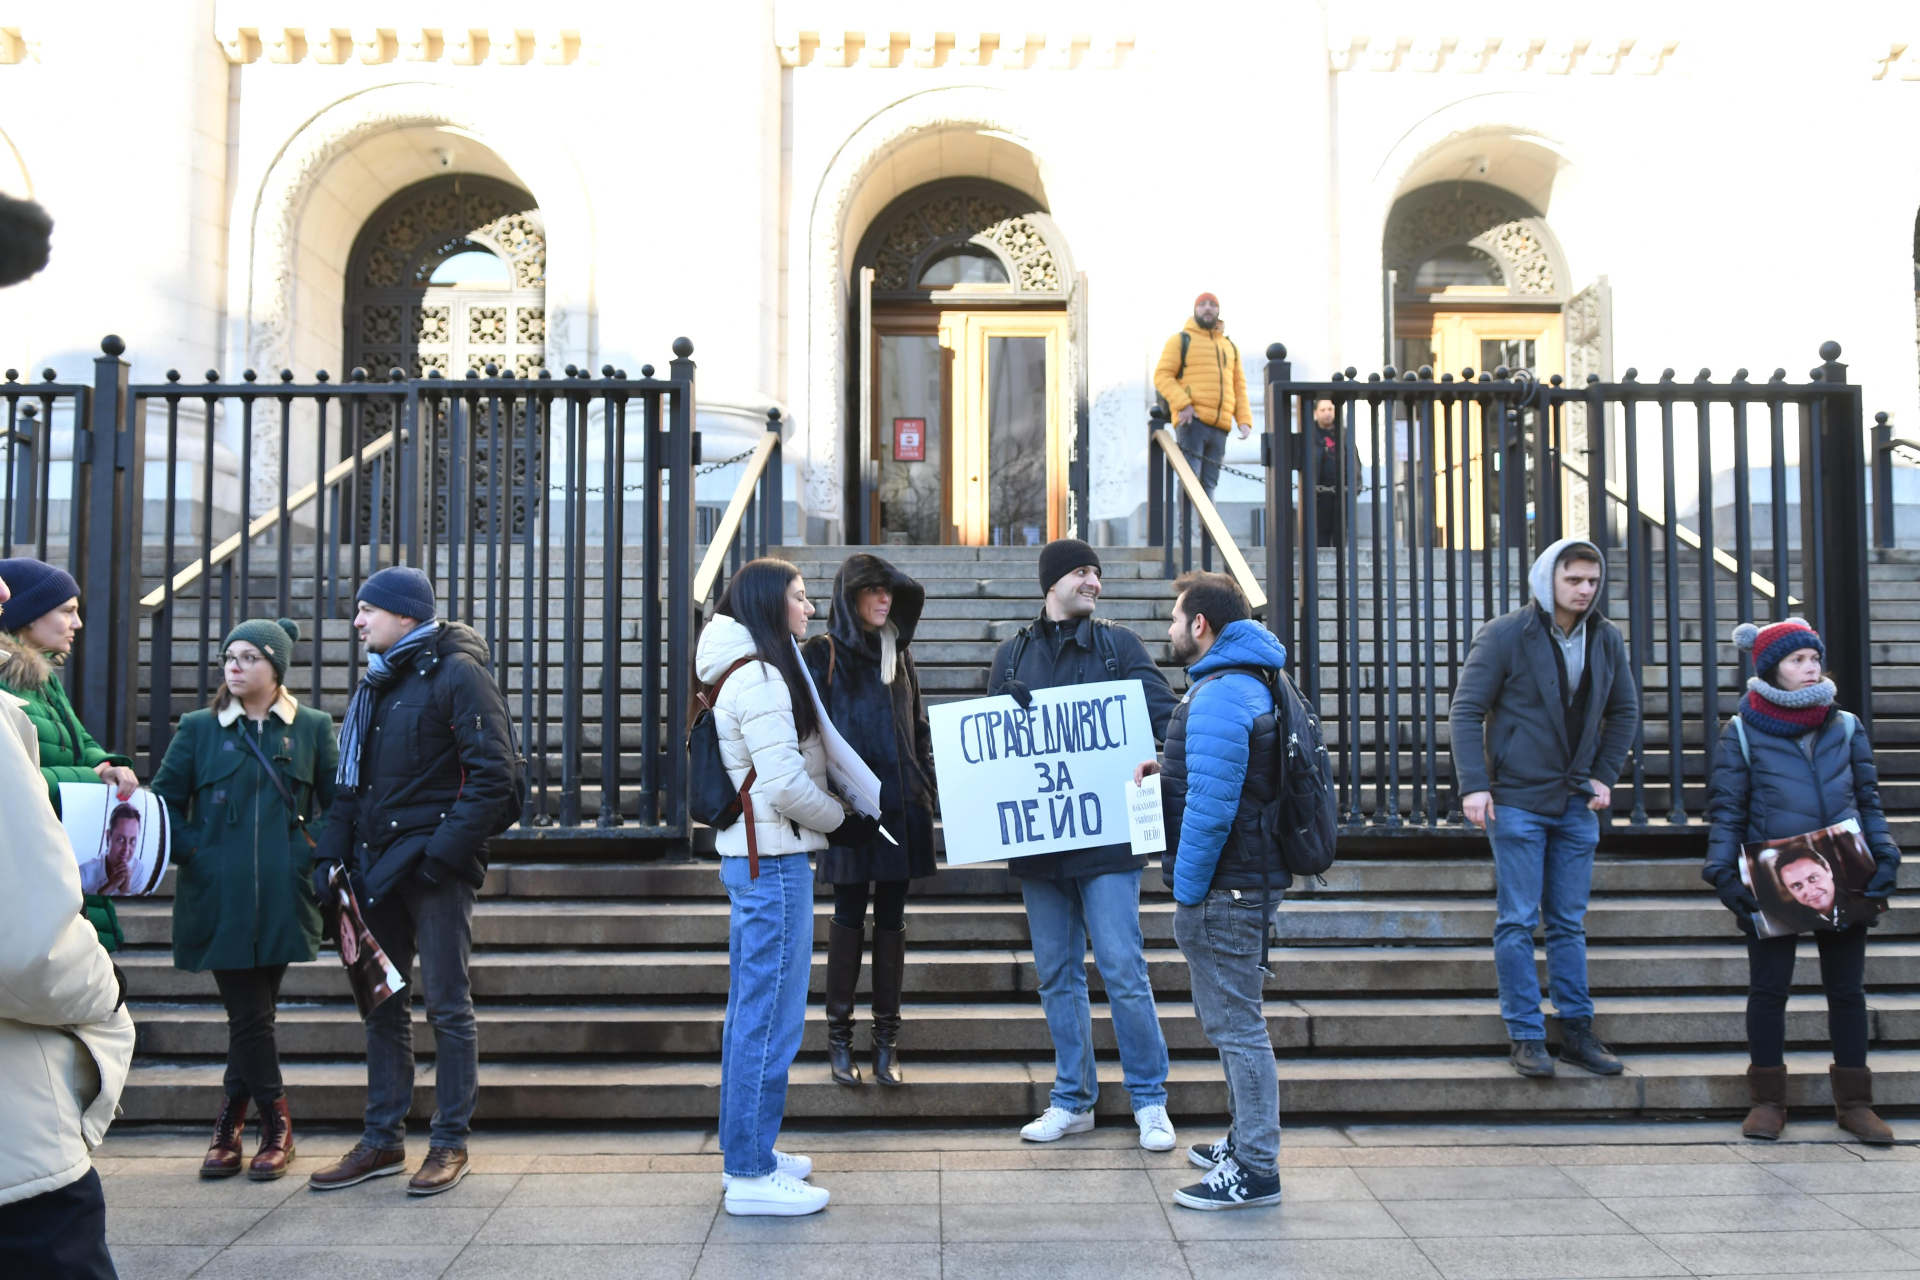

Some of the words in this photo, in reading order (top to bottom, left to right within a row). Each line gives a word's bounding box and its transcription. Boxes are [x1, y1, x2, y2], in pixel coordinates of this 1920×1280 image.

[960, 694, 1127, 764] СПРАВЕДЛИВОСТ
[1034, 761, 1074, 793] ЗА
[996, 792, 1102, 845] ПЕЙО
[1143, 826, 1161, 841] ПЕЙО
